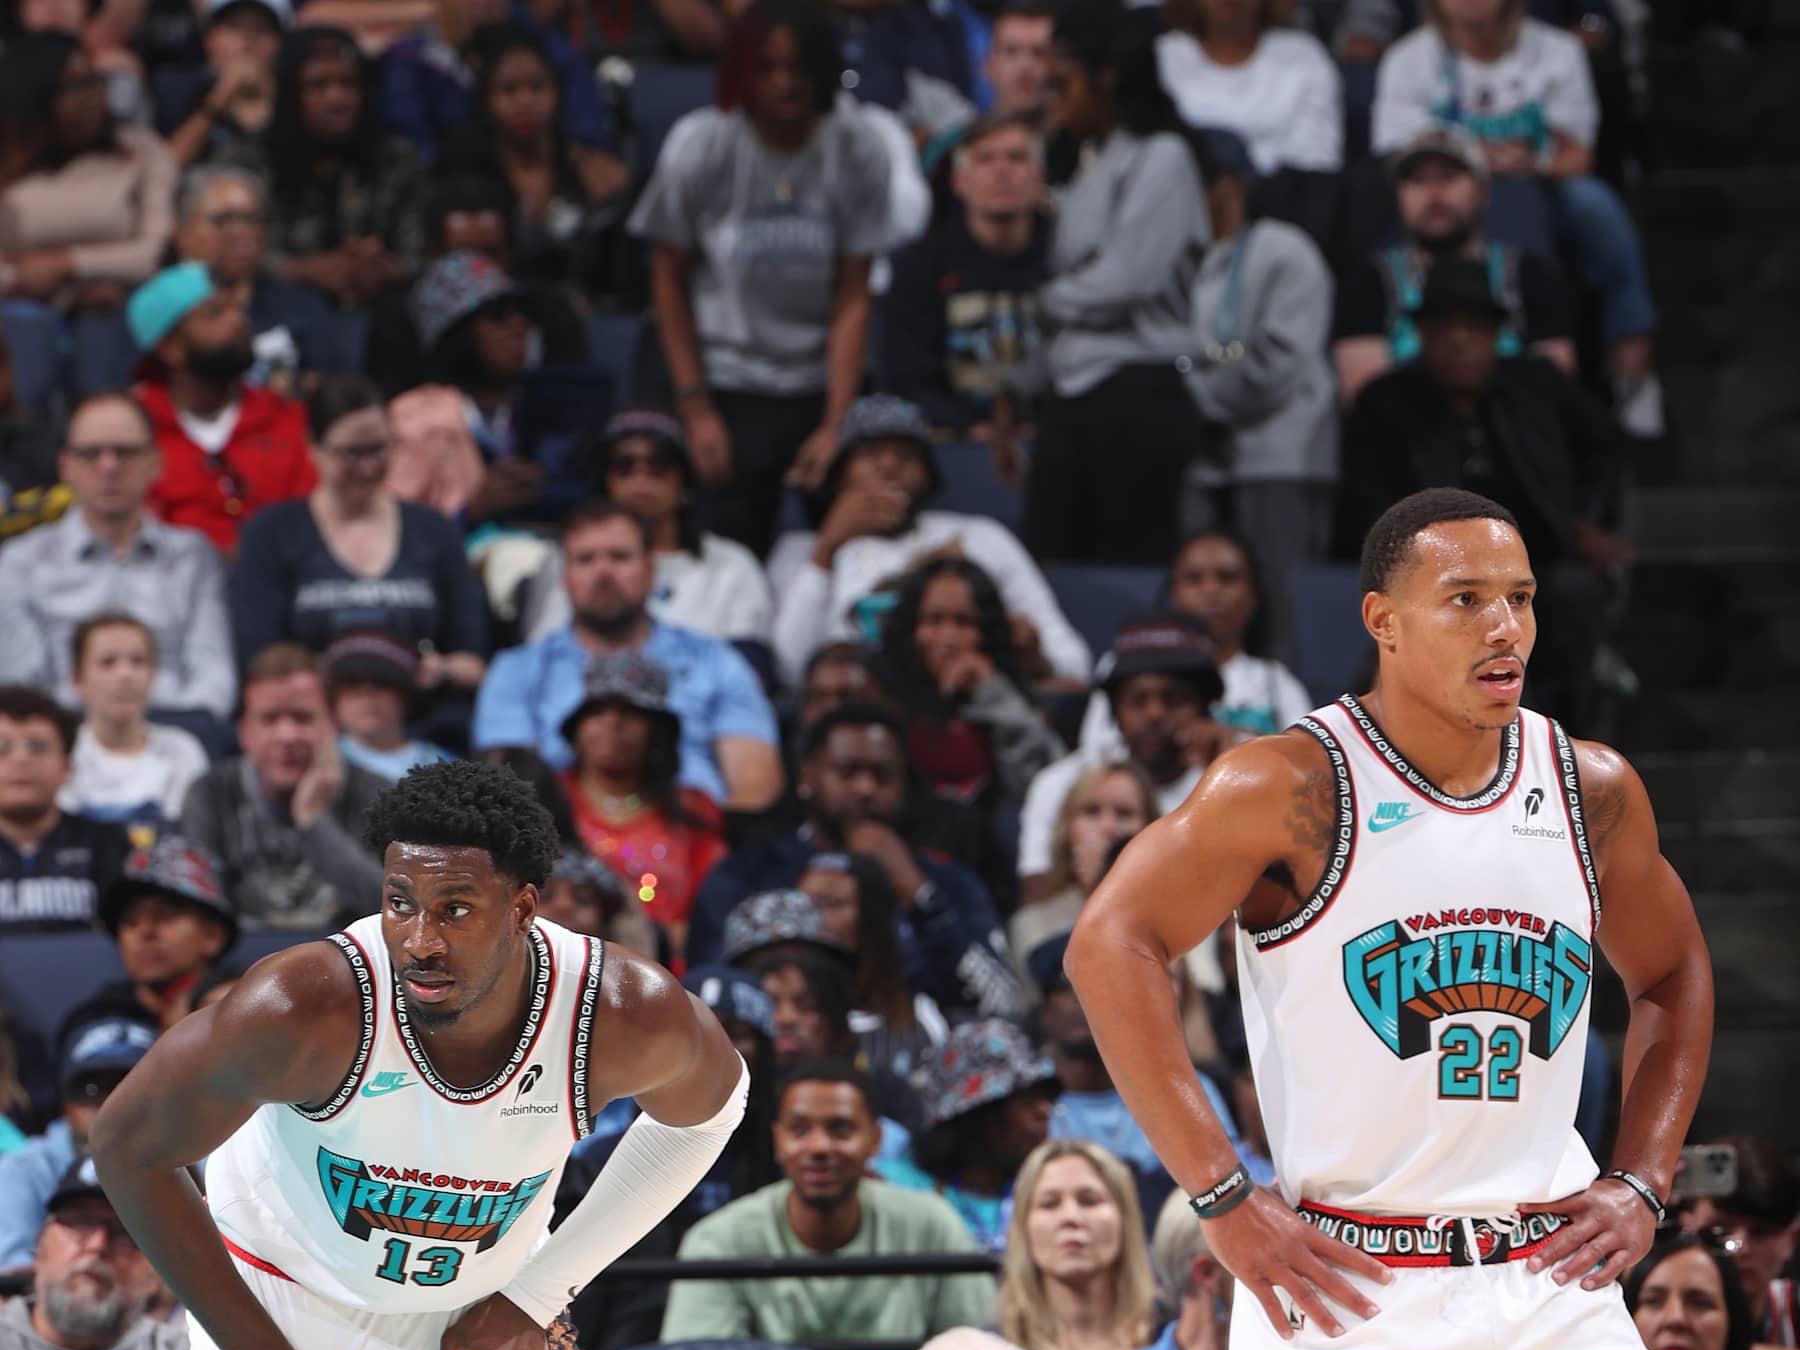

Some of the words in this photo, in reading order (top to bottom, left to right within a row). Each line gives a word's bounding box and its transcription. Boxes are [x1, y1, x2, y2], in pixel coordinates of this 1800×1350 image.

[1375, 802, 1409, 819] NIKE
[1512, 825, 1565, 840] Robinhood
[1405, 908, 1546, 935] VANCOUVER
[1342, 919, 1592, 1060] GRIZZLIES
[1437, 1023, 1524, 1103] 22
[371, 1071, 408, 1087] NIKE
[500, 1103, 558, 1118] Robinhood
[368, 1164, 512, 1192] VANCOUVER
[1195, 1191, 1216, 1207] Stay
[1214, 1170, 1243, 1196] Hungry
[317, 1145, 554, 1254] GRIZZLIES
[375, 1237, 465, 1286] 13
